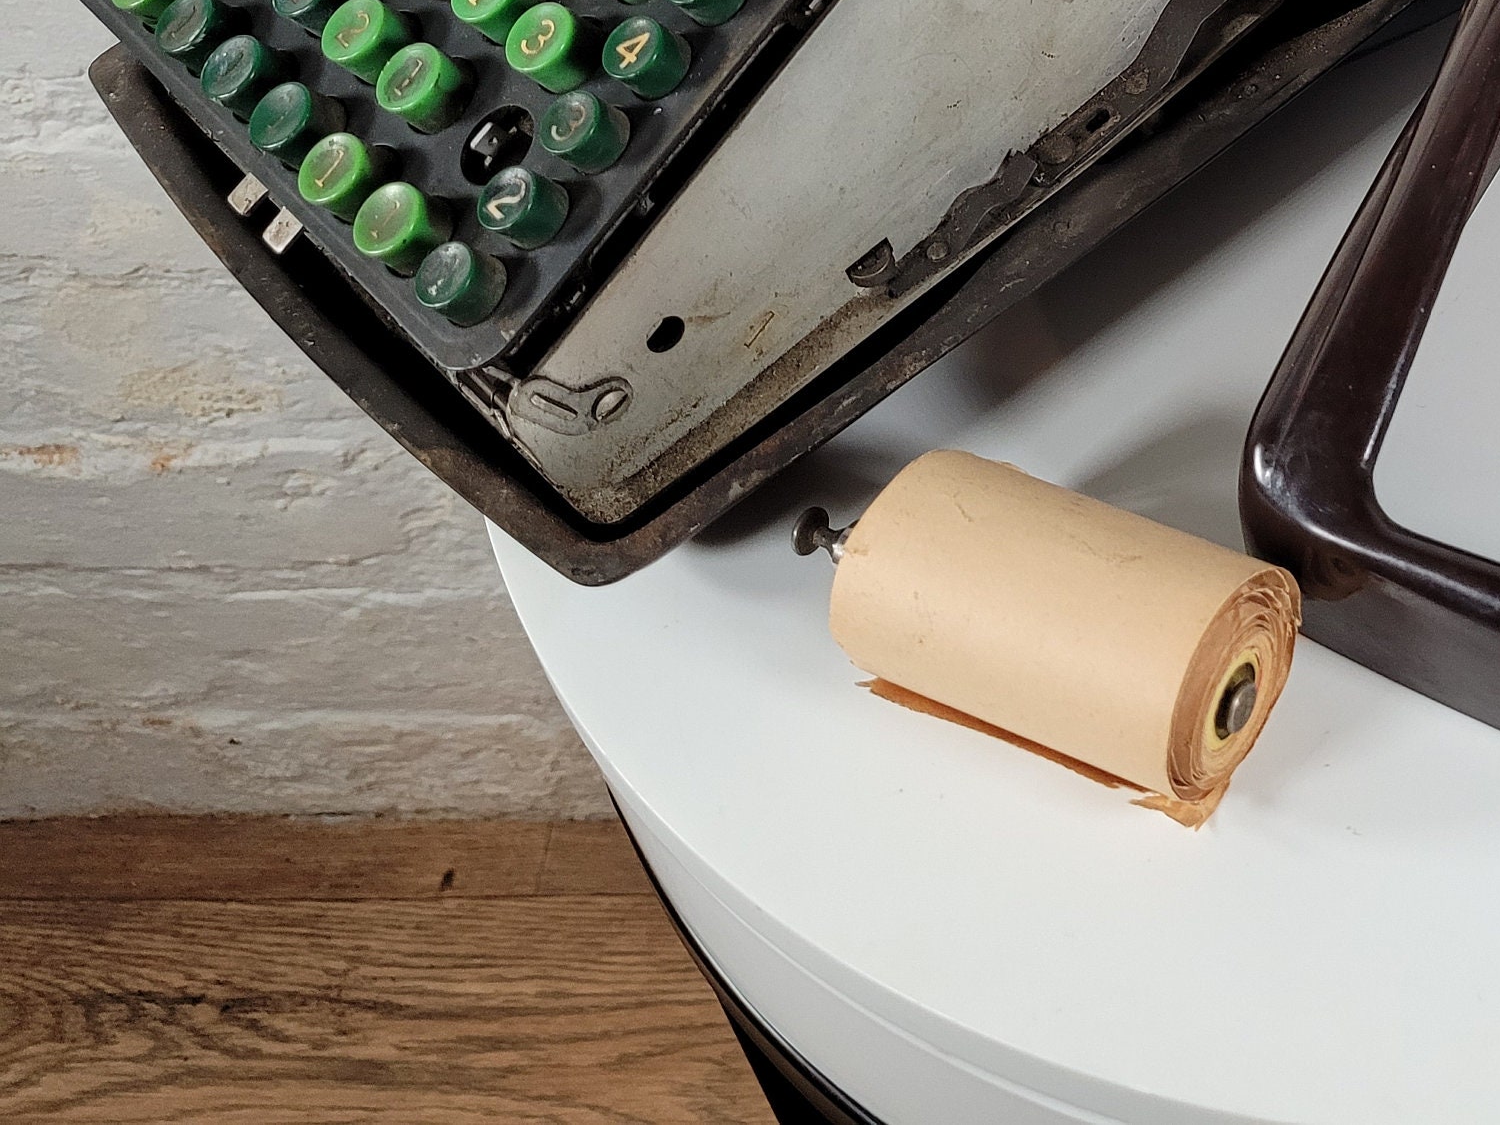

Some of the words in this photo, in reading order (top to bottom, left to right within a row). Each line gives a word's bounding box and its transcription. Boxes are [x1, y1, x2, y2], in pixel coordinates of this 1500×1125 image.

[337, 11, 370, 49] 2
[521, 19, 555, 55] 3
[616, 32, 651, 70] 4
[394, 59, 423, 97] 1
[551, 105, 585, 142] 3
[314, 148, 345, 188] 1
[486, 179, 526, 221] 2
